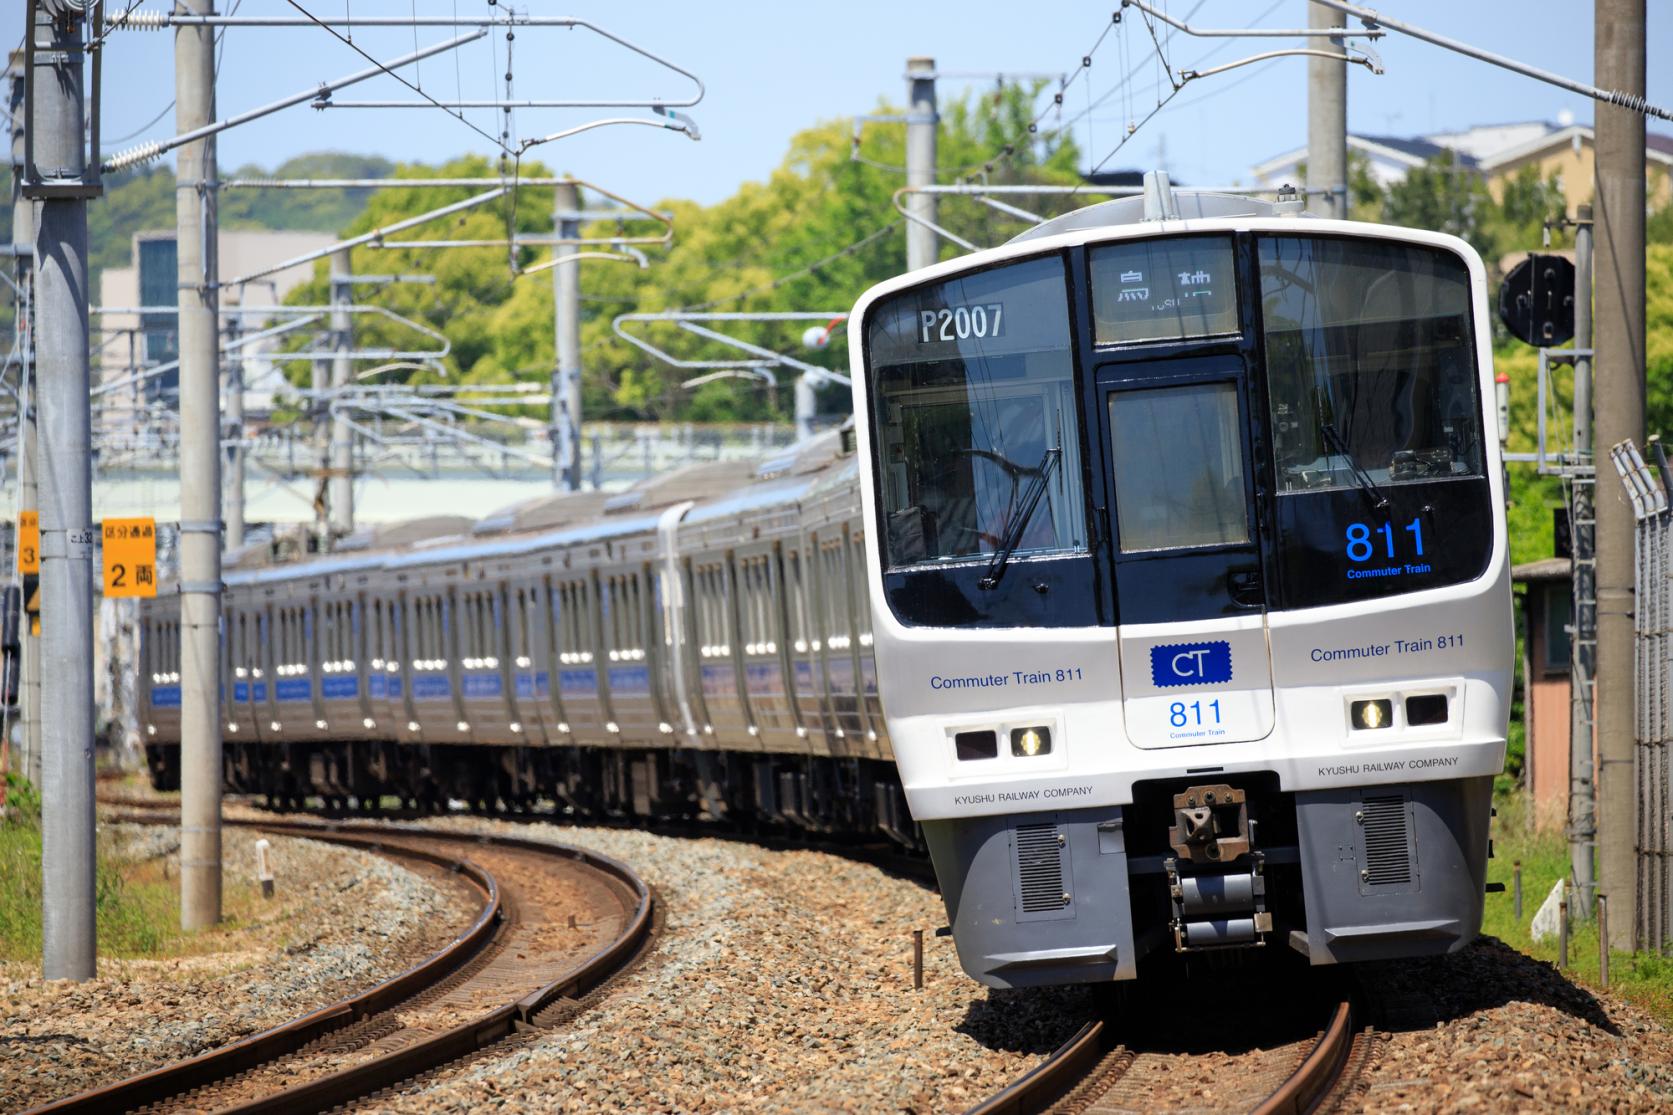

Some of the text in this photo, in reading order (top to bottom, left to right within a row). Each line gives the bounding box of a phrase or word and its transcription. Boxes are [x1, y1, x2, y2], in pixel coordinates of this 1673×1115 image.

[920, 303, 1003, 343] P2007
[1345, 517, 1424, 562] 811
[23, 547, 35, 564] 3
[111, 563, 126, 588] 2
[135, 564, 153, 586] 両
[1347, 562, 1431, 580] Commuter Train
[1310, 633, 1465, 663] Commuter Train 811
[1171, 649, 1211, 678] CT
[930, 667, 1084, 690] Commuter Train 811
[1169, 698, 1222, 728] 811
[1169, 729, 1226, 740] Commuter Train
[1317, 756, 1459, 777] KYUSHU RAILWAY COMPANY
[954, 785, 1094, 806] KYUSHU RAILWAY COMPANY
